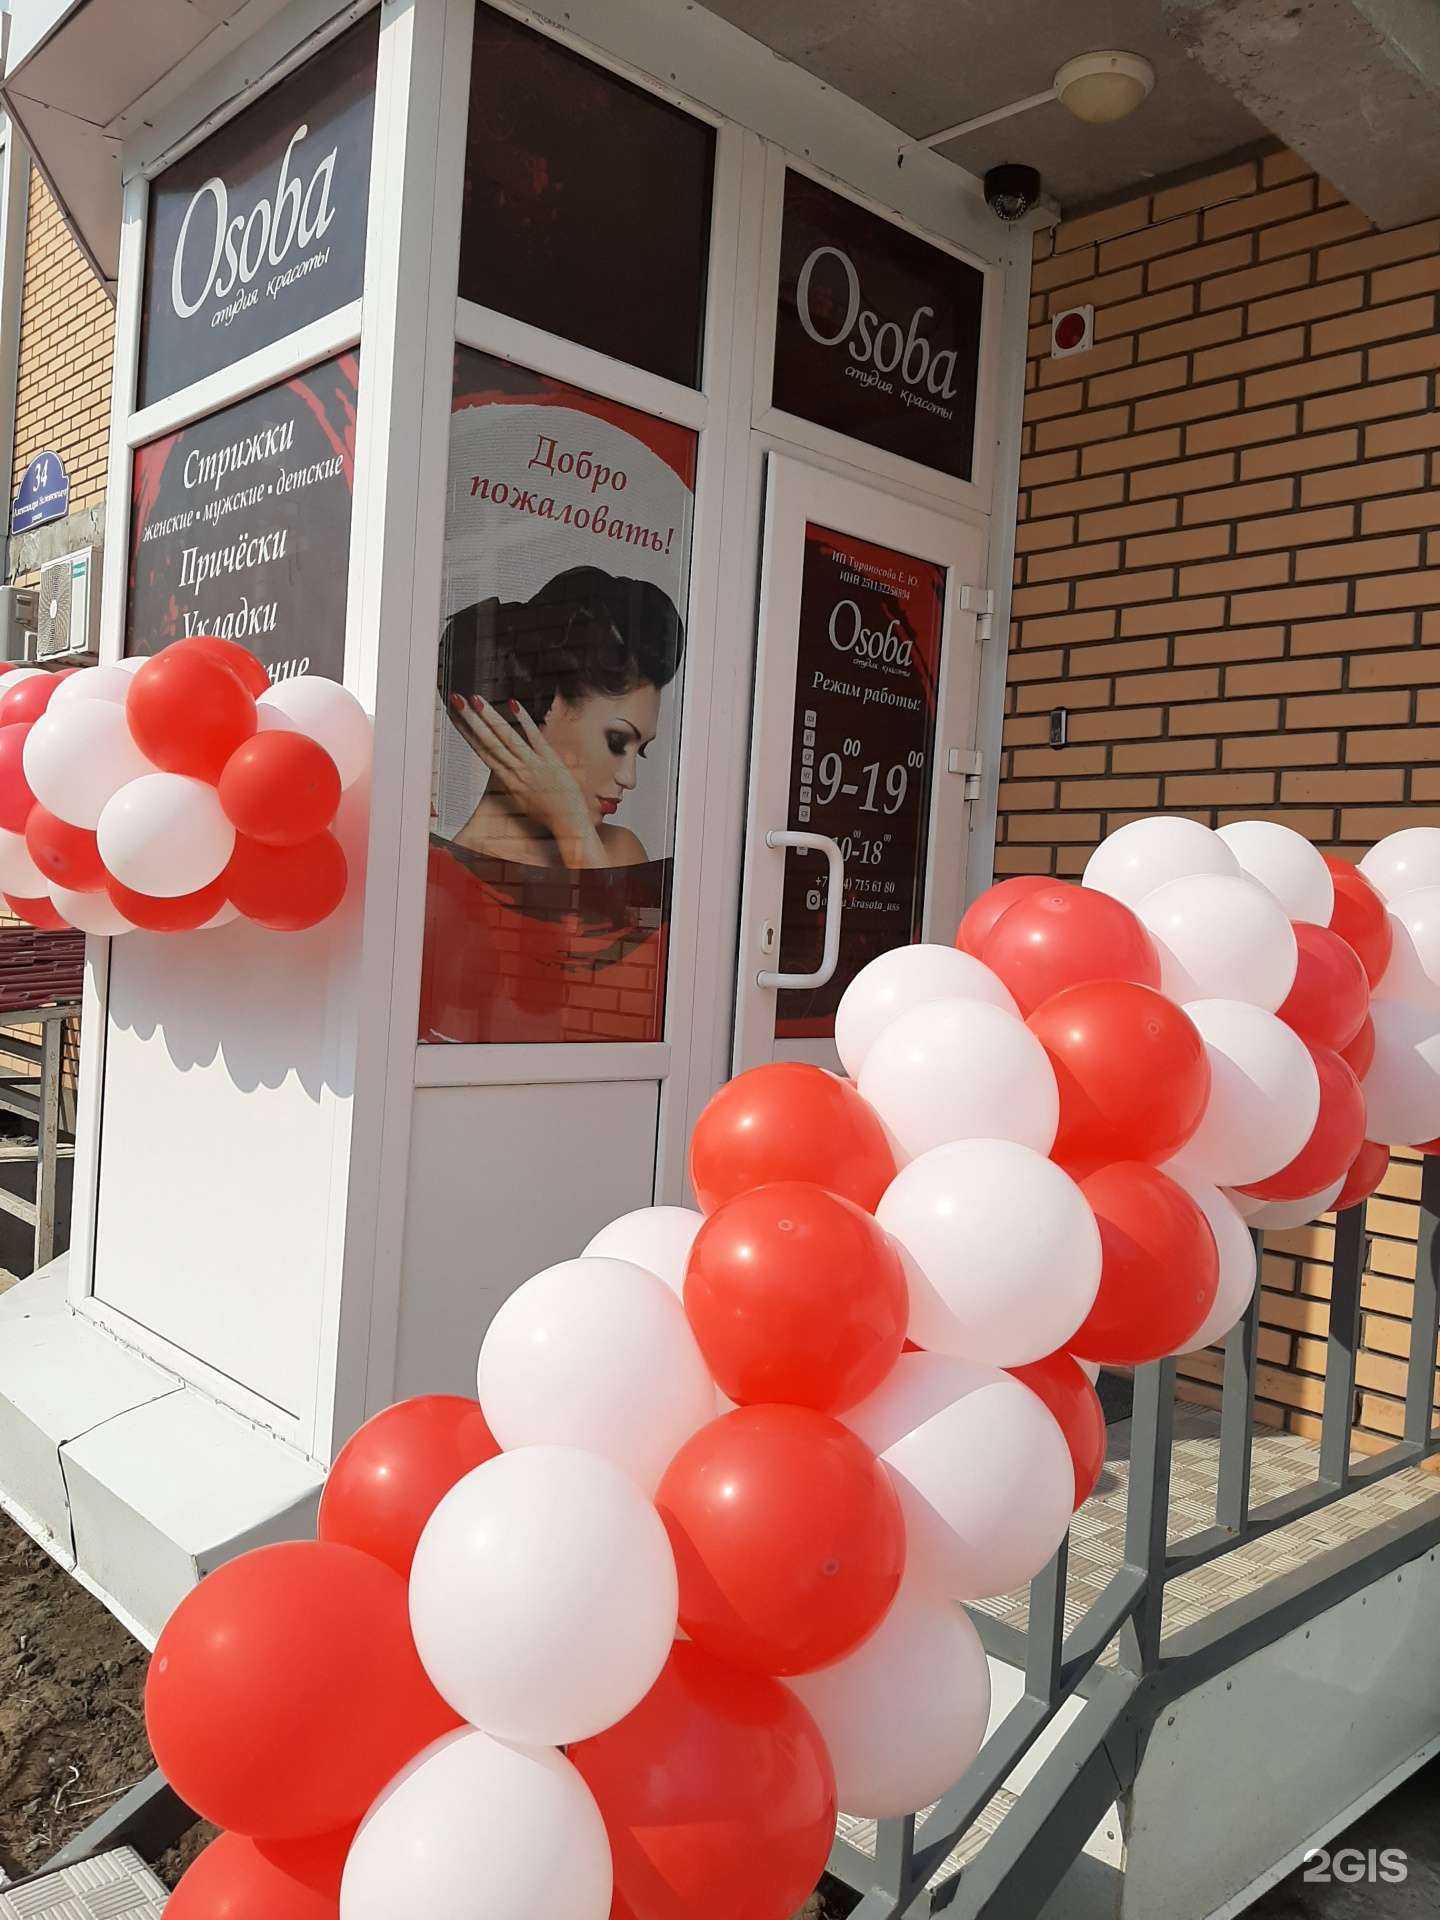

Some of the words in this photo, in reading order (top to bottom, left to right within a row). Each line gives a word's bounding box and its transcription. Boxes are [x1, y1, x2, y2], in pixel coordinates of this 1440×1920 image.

[172, 124, 338, 319] Osoba
[210, 288, 260, 328] студия
[266, 247, 331, 304] красоты
[796, 246, 958, 399] Osoba
[845, 366, 894, 394] студия
[900, 389, 953, 420] красоты
[32, 459, 49, 493] 34
[183, 419, 295, 491] Стрижки
[528, 435, 629, 493] Добро
[143, 508, 193, 543] женские
[202, 484, 265, 526] мужские
[276, 454, 344, 496] детские
[470, 475, 675, 555] пожаловать!
[178, 528, 288, 596] Причёски
[828, 600, 913, 667] Osoba
[811, 671, 861, 698] Режим
[863, 687, 921, 712] работы:
